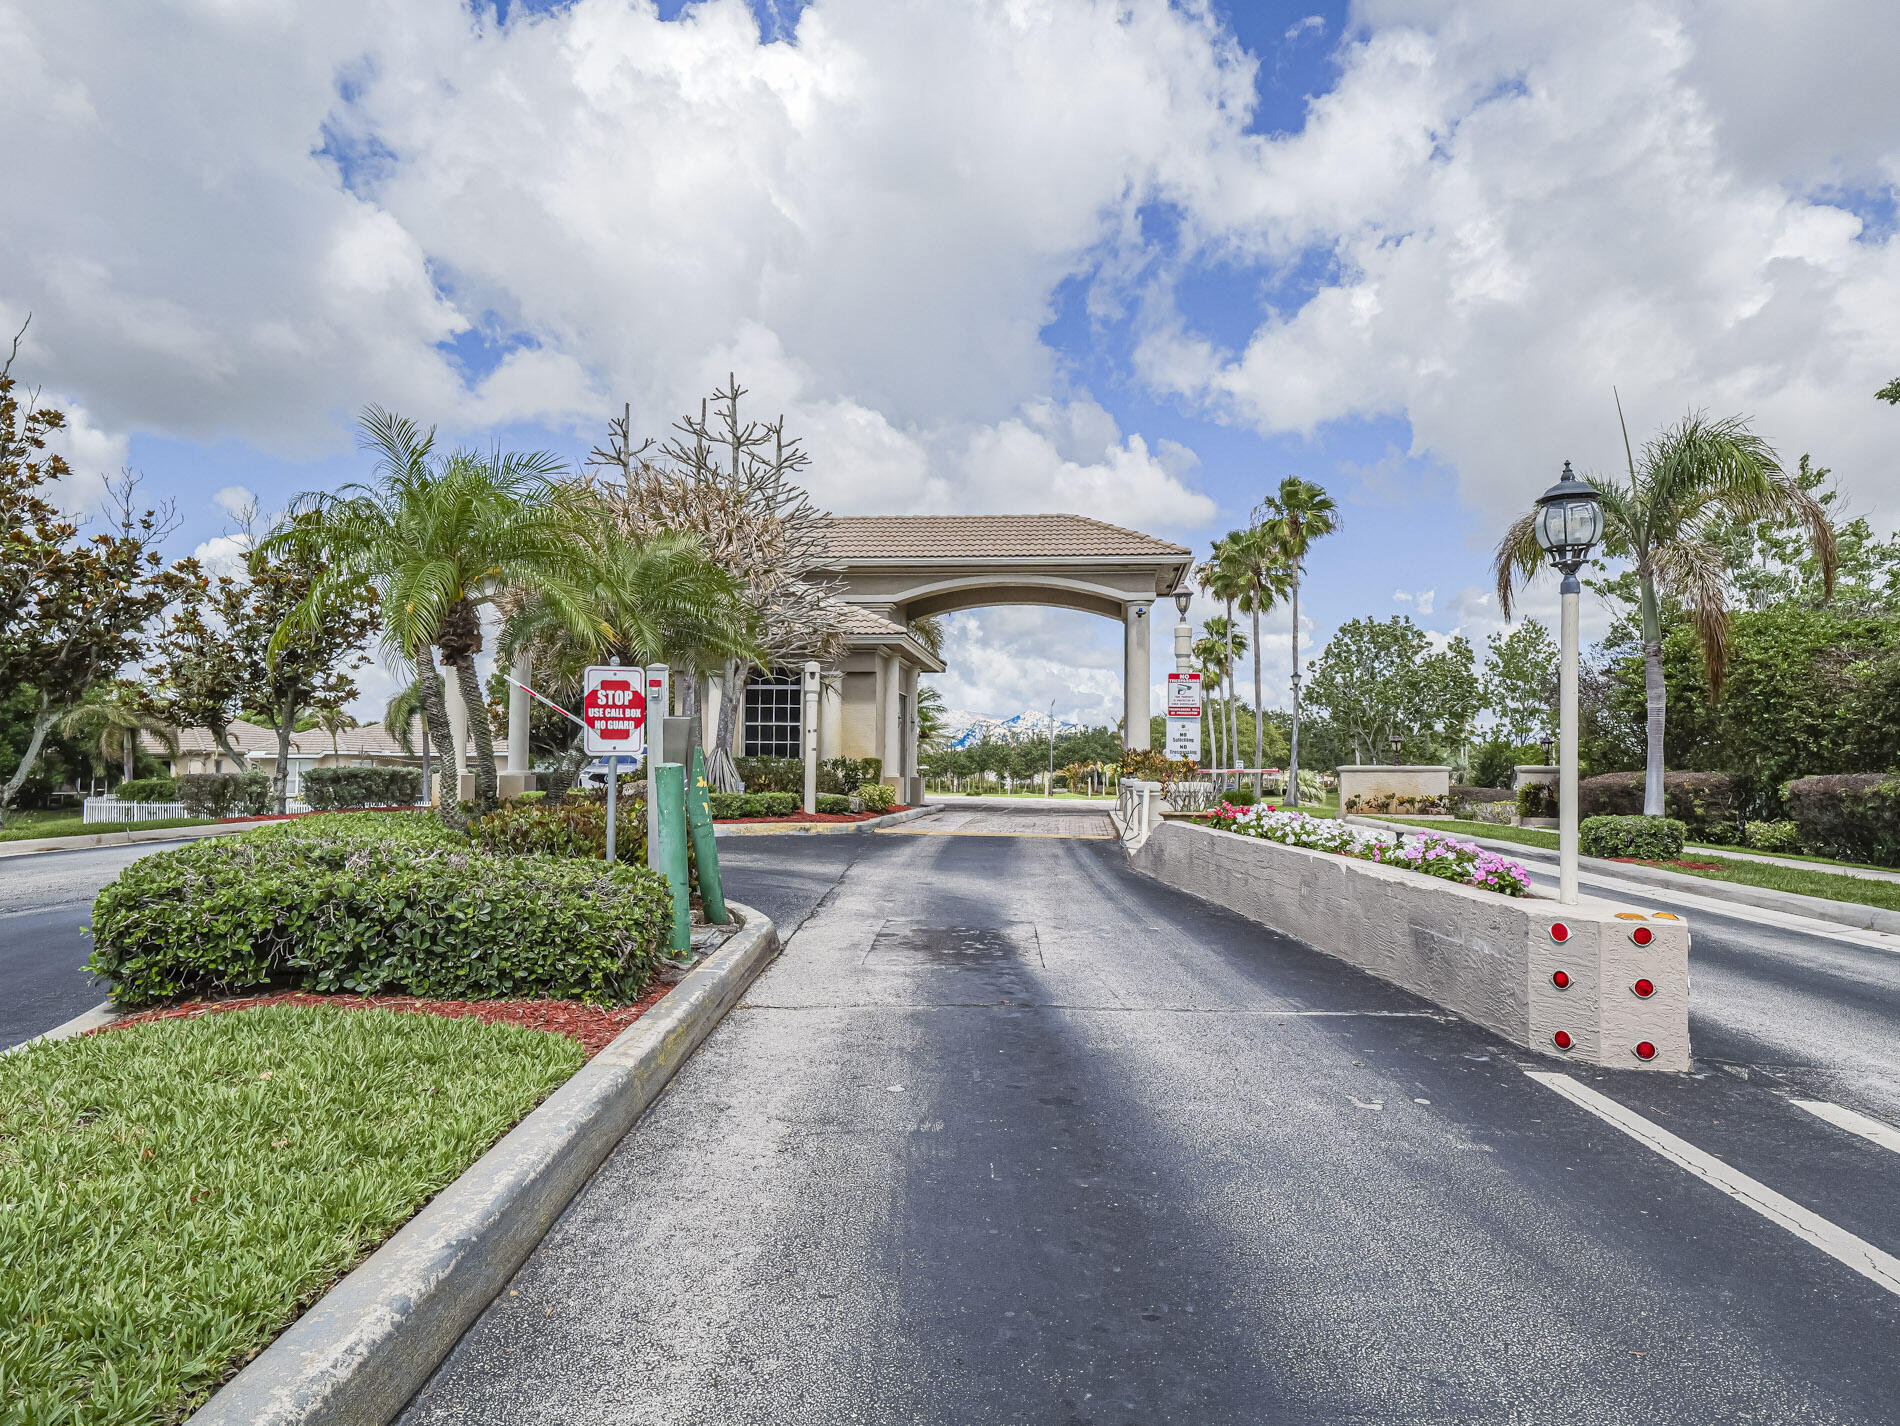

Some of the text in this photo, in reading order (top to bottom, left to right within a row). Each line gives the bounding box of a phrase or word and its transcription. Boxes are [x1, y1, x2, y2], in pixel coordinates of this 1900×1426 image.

[597, 690, 633, 705] STOP
[588, 708, 641, 718] USE CALL BOX
[594, 720, 635, 730] NO GUARD
